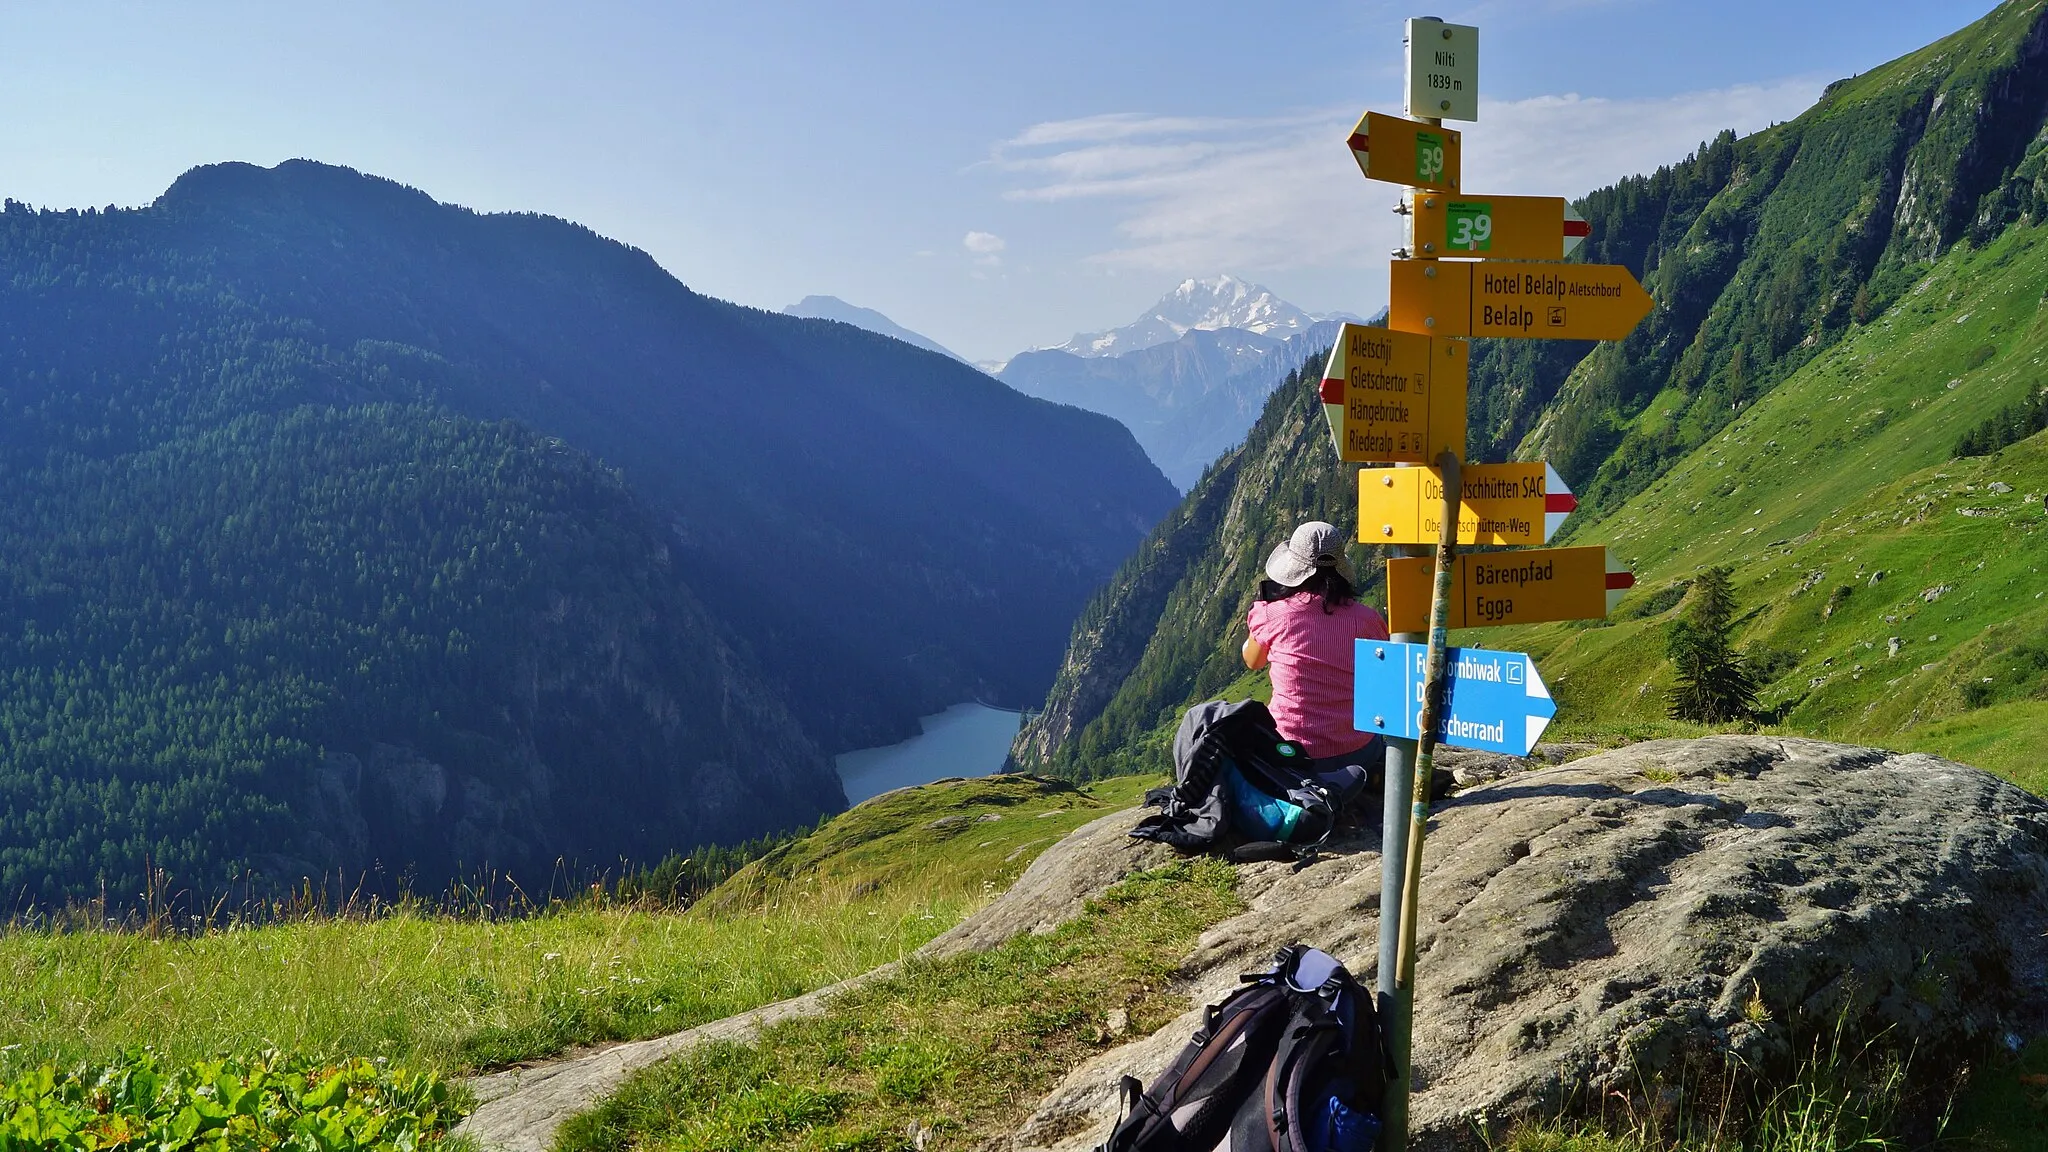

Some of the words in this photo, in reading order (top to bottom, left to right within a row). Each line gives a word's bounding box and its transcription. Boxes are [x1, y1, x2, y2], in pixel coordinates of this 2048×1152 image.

[1435, 51, 1455, 67] Nilti
[1428, 73, 1450, 89] 1839
[1453, 79, 1462, 91] m
[1420, 146, 1444, 175] 39
[1452, 214, 1492, 245] 39
[1484, 273, 1520, 294] Hotel
[1525, 274, 1566, 301] Belalp
[1568, 282, 1621, 297] Aletschbord
[1483, 304, 1533, 332] Belalp
[1351, 335, 1392, 366] Aletschji
[1351, 366, 1407, 392] Gletschertor
[1350, 398, 1409, 426] Hängebrücke
[1349, 429, 1393, 458] Riederalp
[1425, 476, 1518, 500] Obetschhütten
[1522, 475, 1544, 498] SAC
[1425, 518, 1530, 537] Obetschhütten-Weg
[1476, 559, 1553, 587] Bärenpfad
[1476, 596, 1513, 621] Egga
[1416, 652, 1501, 683] Fuornbiwak
